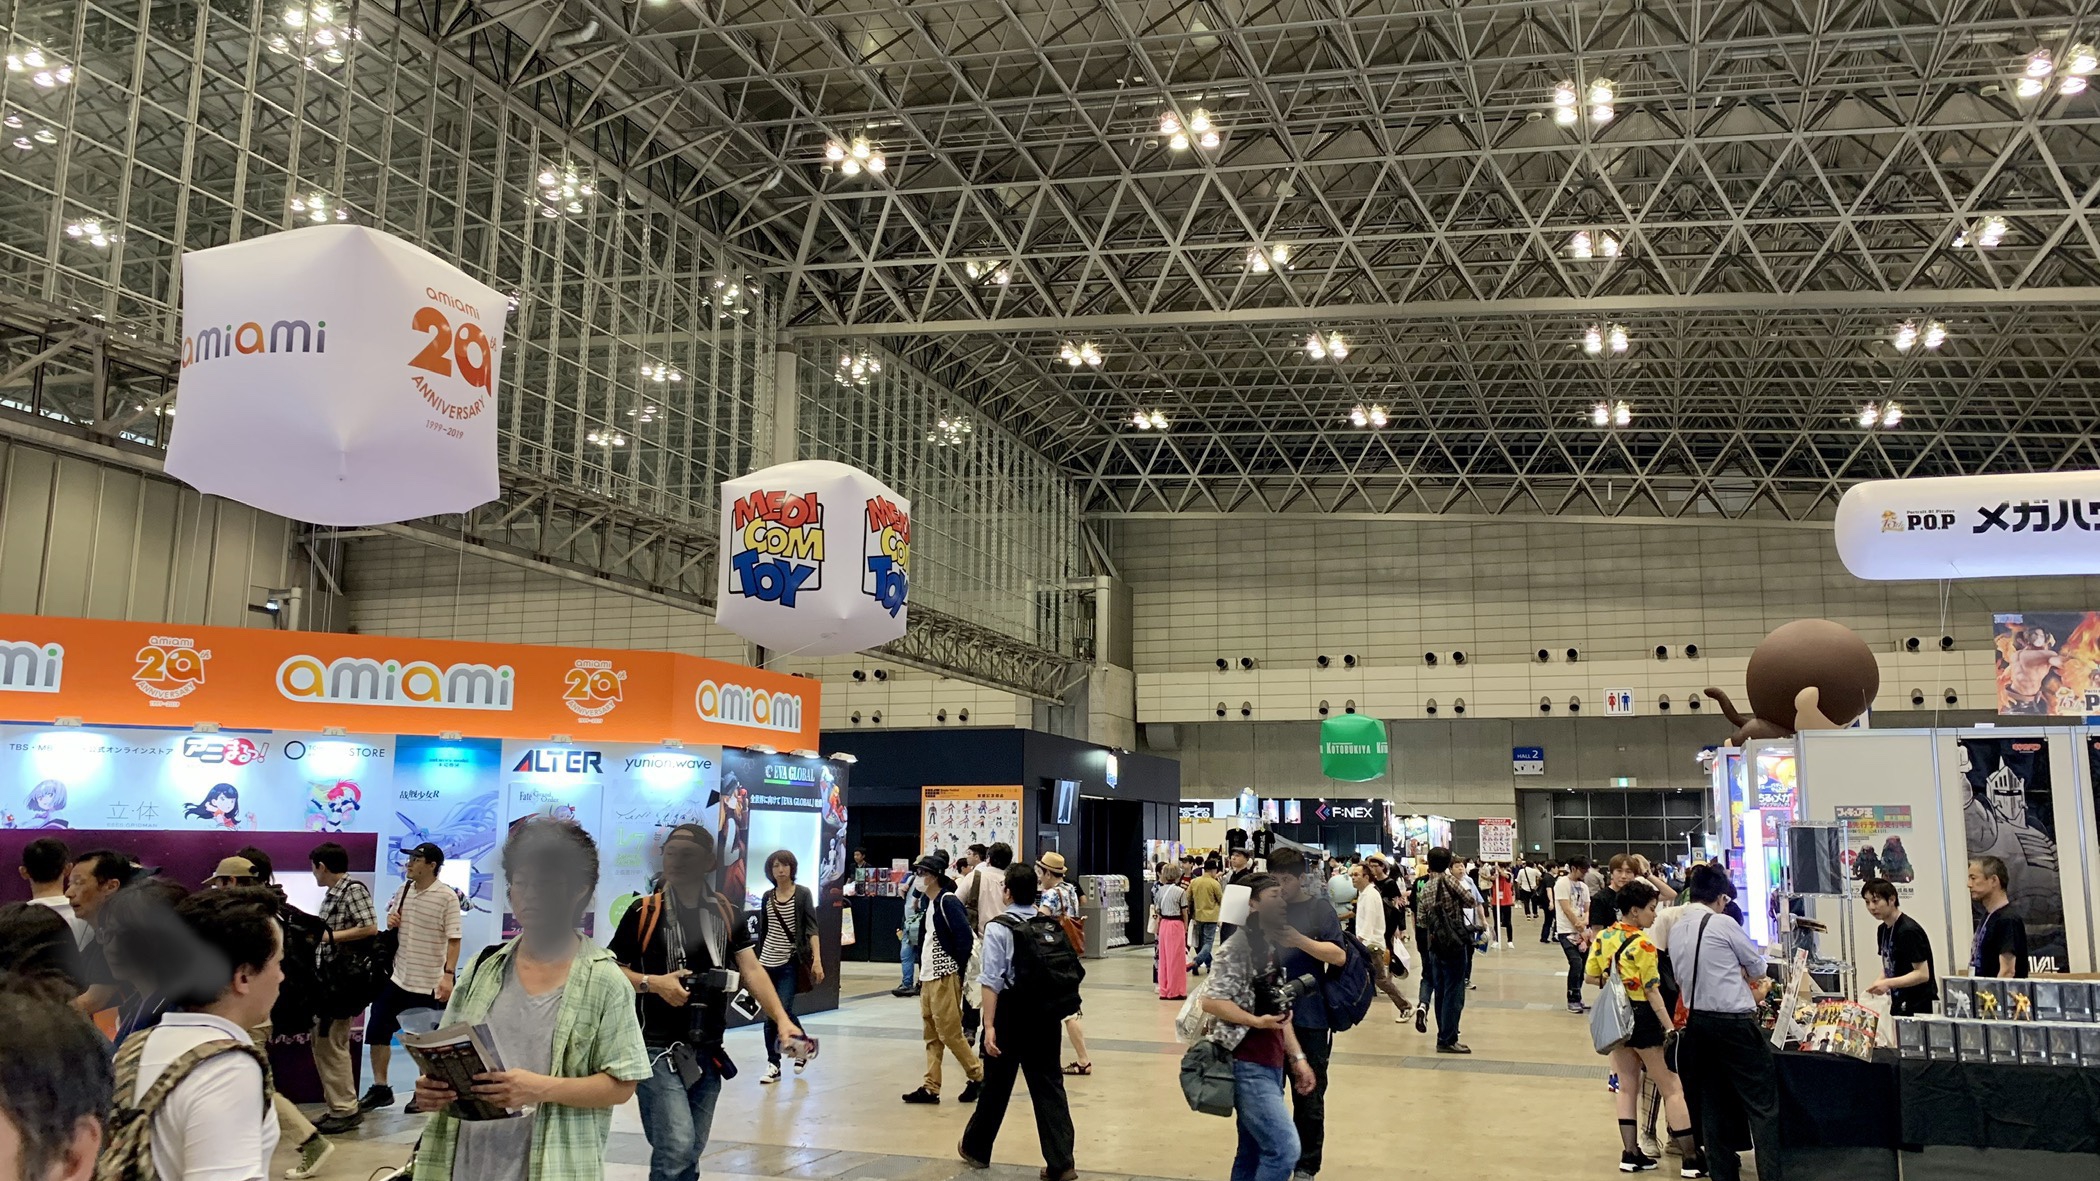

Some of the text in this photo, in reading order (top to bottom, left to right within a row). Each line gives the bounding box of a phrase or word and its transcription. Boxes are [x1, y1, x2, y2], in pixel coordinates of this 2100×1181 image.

[426, 287, 480, 320] amiami
[182, 320, 327, 368] amiami
[411, 375, 486, 420] ANNIVERSARY
[425, 419, 464, 440] 1999-2019
[734, 489, 819, 532] MEDI
[1907, 514, 1955, 530] P.O.P
[743, 517, 825, 562] COM
[732, 548, 816, 608] TOY
[150, 637, 193, 647] amiami
[136, 681, 195, 698] ANNIVERSARY
[282, 660, 510, 706] amiami
[699, 684, 801, 729] amiami
[349, 748, 386, 758] STORE
[1326, 742, 1371, 754] KOTOBUKIYA
[1532, 750, 1538, 759] 2
[512, 749, 604, 774] ALTER
[789, 766, 815, 782] GLOBAL
[520, 791, 532, 801] Fate
[1332, 807, 1373, 818] F:NEX
[1836, 807, 1873, 818] フィギュア王
